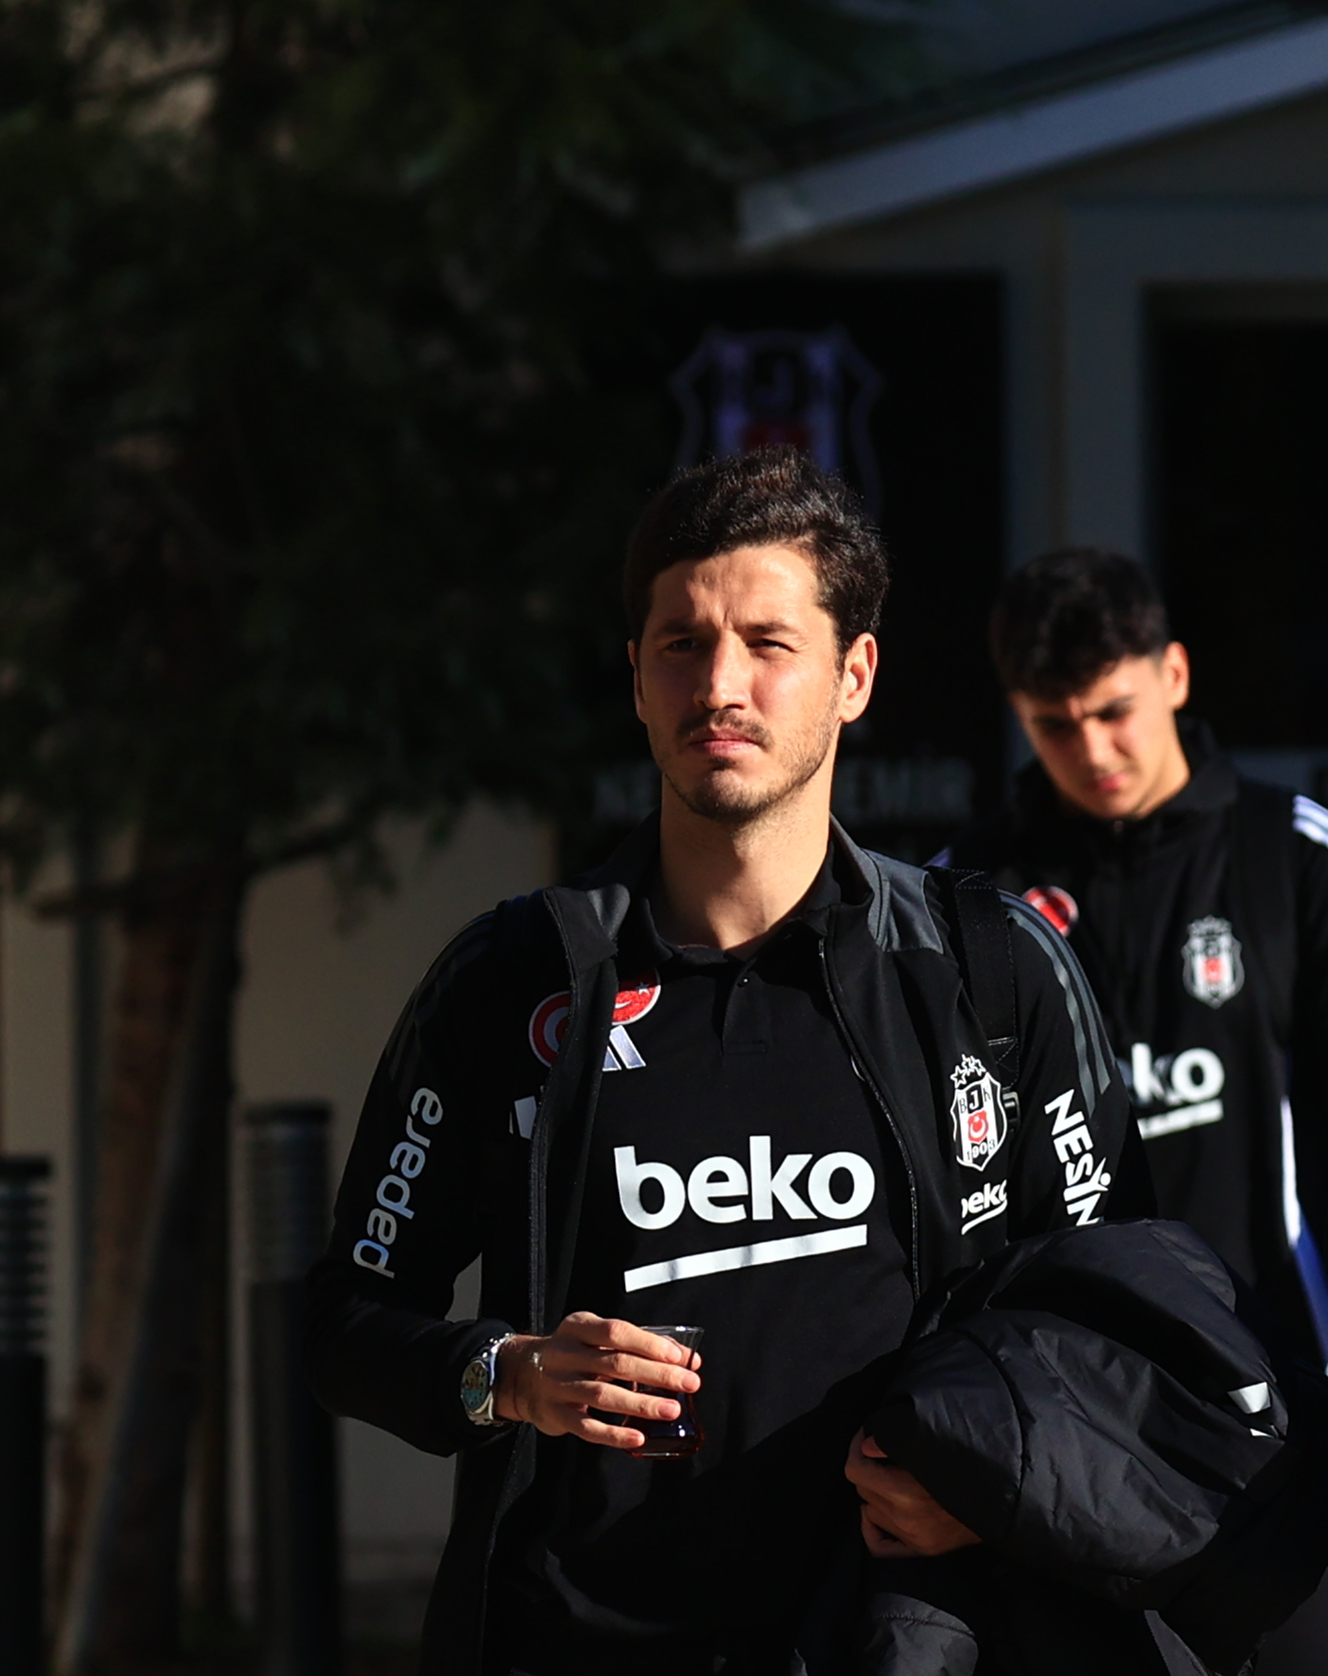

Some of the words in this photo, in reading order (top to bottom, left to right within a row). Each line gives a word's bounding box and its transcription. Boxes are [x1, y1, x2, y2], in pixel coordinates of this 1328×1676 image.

[1118, 1042, 1225, 1106] ko
[352, 1086, 444, 1279] papara
[613, 1135, 876, 1231] beko
